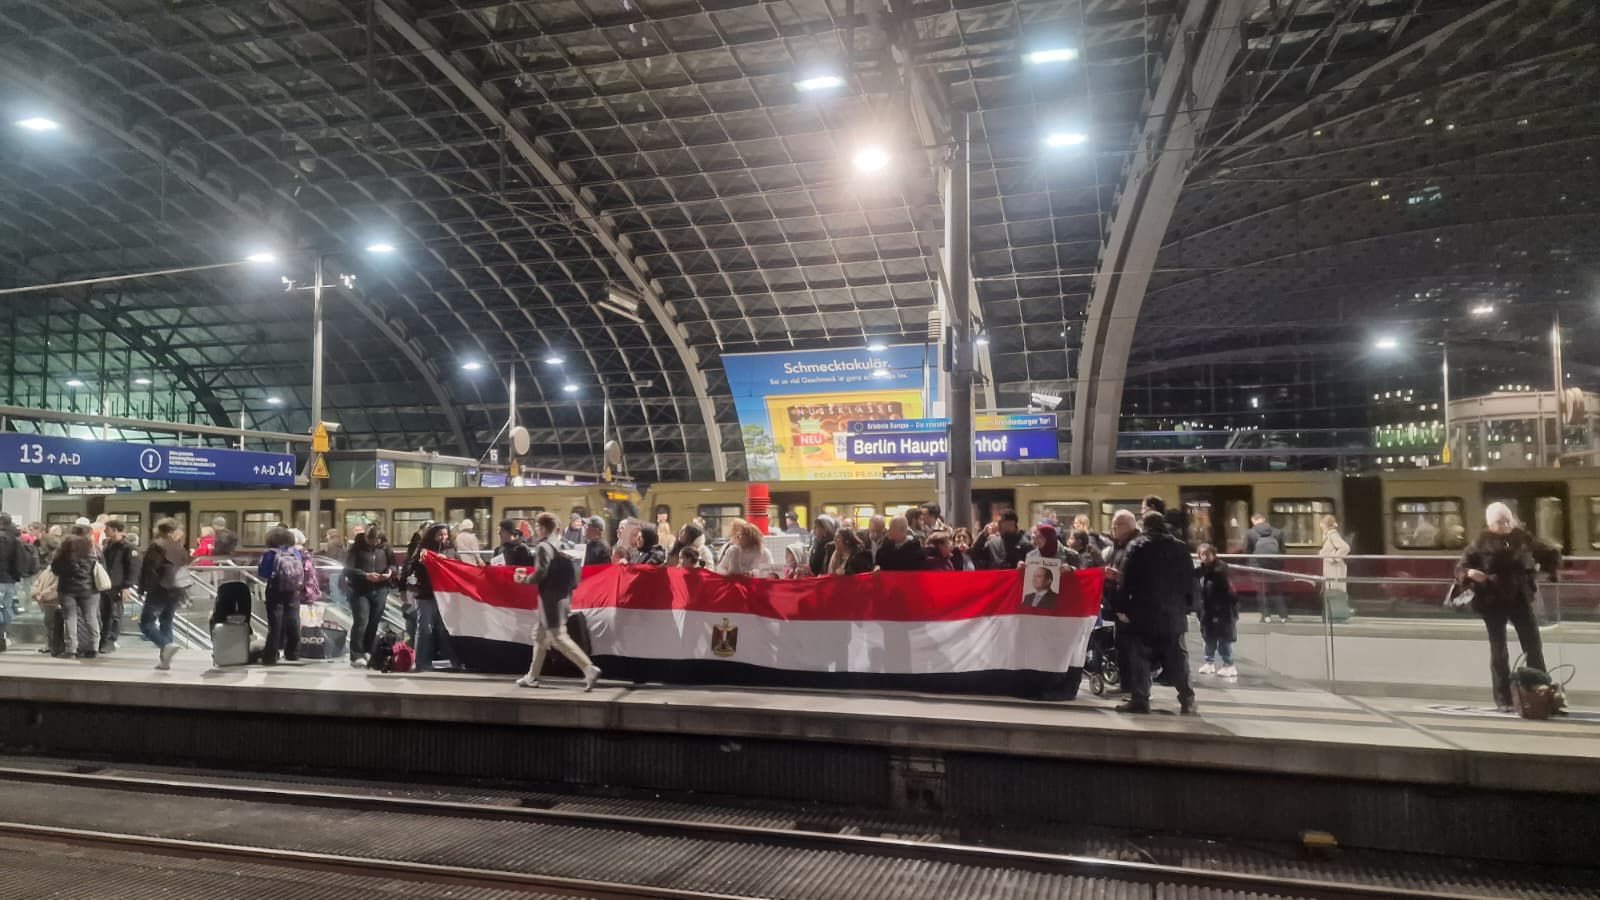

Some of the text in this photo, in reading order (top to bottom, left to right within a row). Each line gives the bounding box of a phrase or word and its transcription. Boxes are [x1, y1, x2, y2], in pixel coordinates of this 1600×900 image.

[783, 358, 891, 374] Schmecktakulär.
[800, 434, 823, 445] NEU
[854, 438, 897, 455] Berlin
[20, 443, 81, 466] 13 A-D
[260, 461, 293, 477] A-D 14
[378, 463, 390, 477] 15
